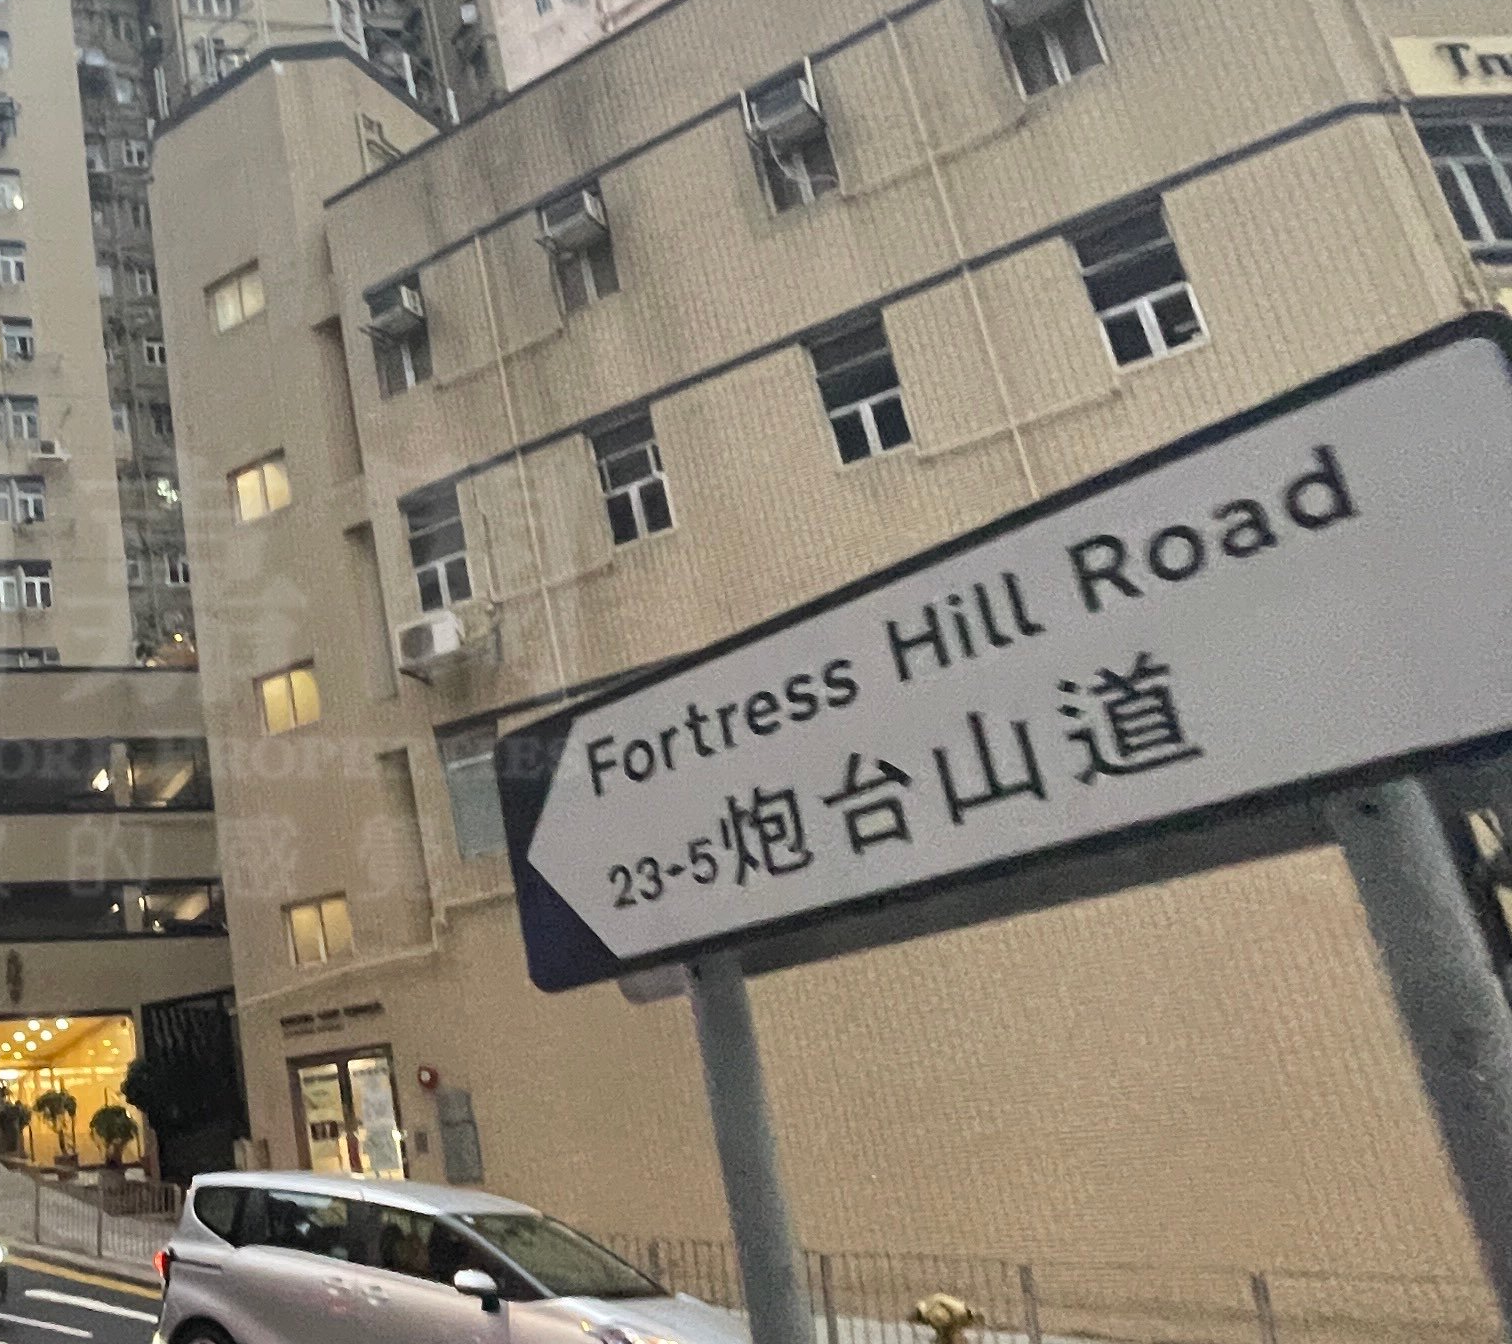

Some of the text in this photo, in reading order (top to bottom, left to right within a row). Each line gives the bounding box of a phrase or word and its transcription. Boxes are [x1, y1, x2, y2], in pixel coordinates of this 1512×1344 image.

[586, 444, 1357, 795] Fortress Hill Road
[716, 651, 1203, 887] 炮台山道
